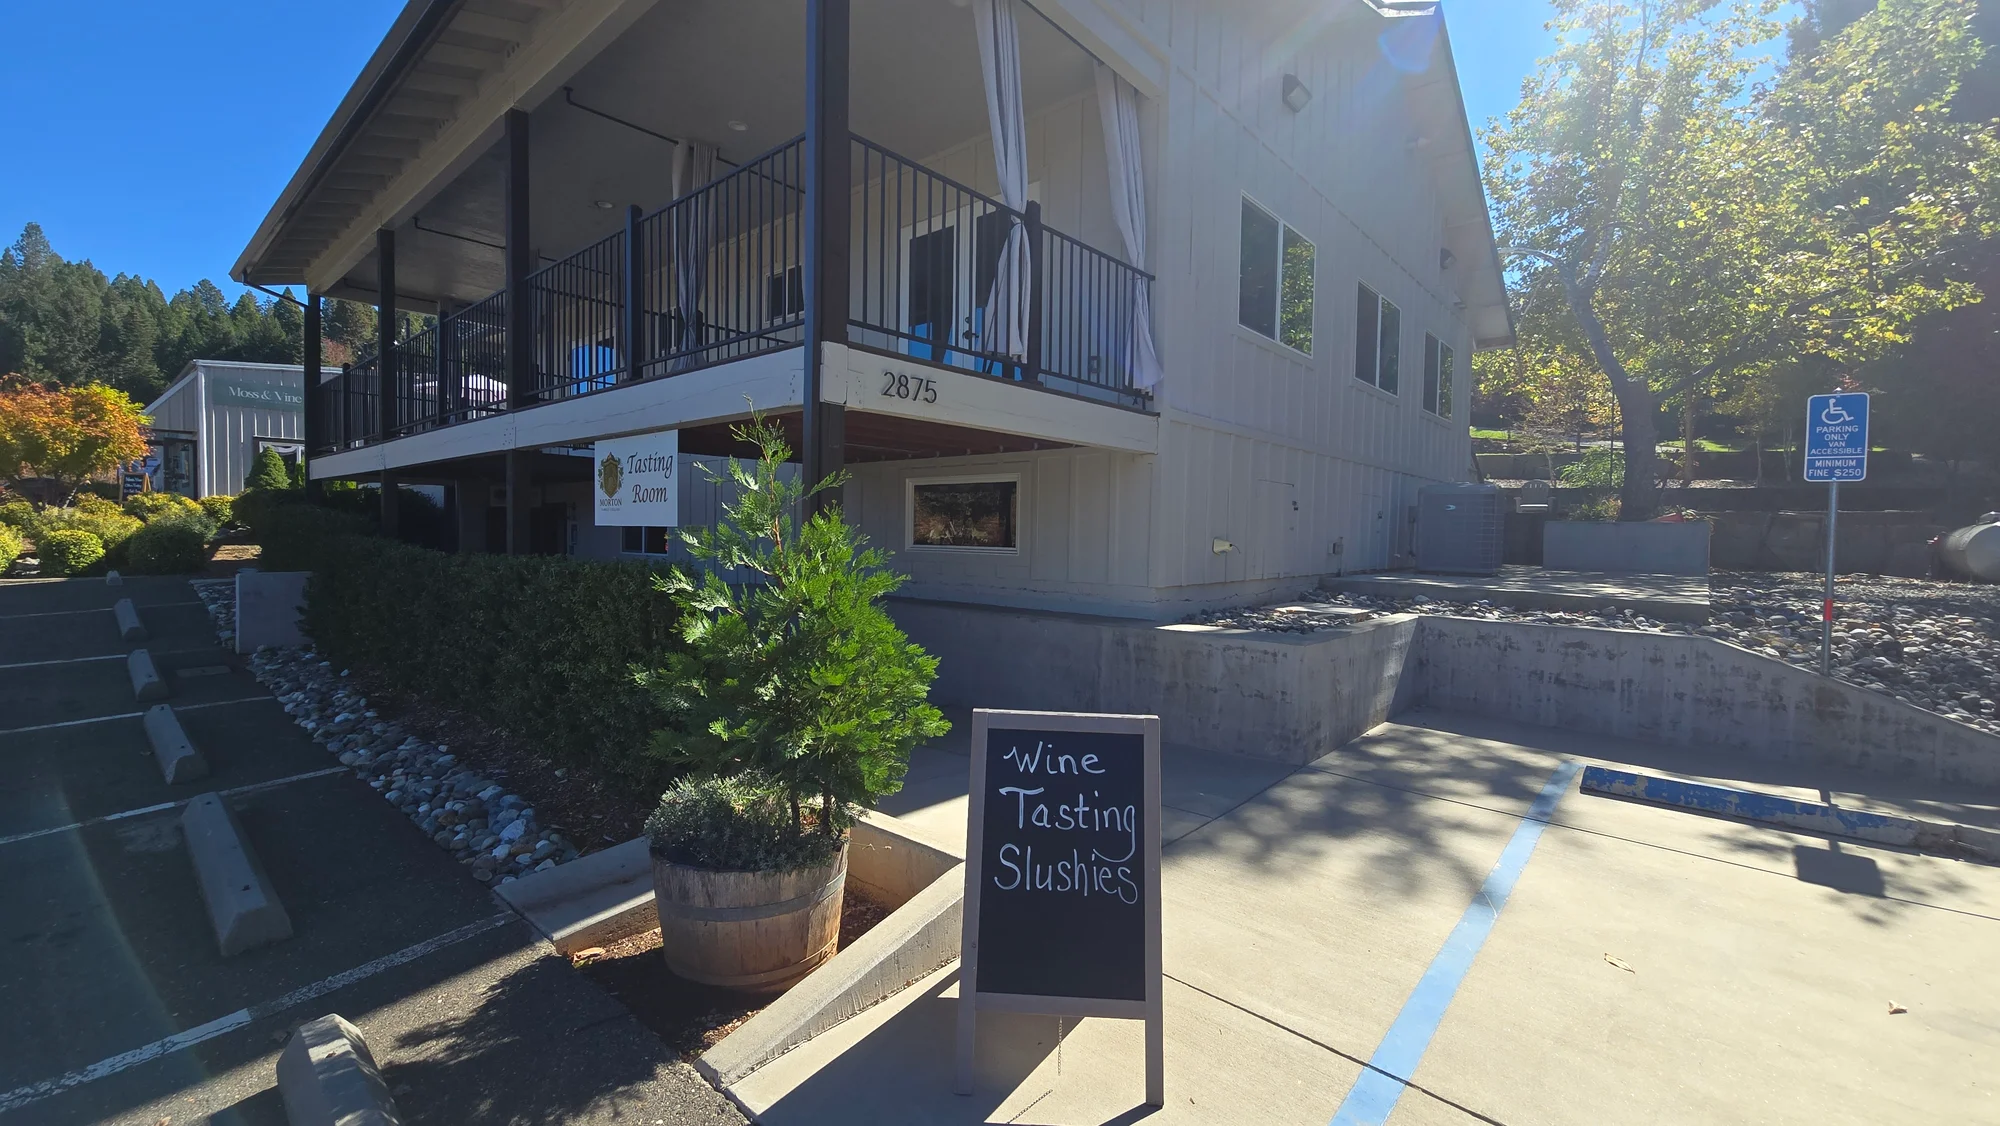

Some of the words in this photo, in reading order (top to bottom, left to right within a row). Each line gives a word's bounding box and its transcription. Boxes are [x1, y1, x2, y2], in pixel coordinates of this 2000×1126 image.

[228, 386, 260, 399] Moss
[261, 390, 272, 400] &
[274, 391, 303, 404] Vine
[881, 371, 937, 404] 2875
[1816, 425, 1859, 433] PARKING
[1824, 433, 1849, 441] ONLY
[1810, 447, 1863, 455] ACCESSIBLE
[626, 451, 674, 479] Tasting
[1815, 459, 1857, 467] MINIMUM
[1808, 469, 1829, 477] FINE
[599, 498, 622, 507] MORTON
[631, 484, 668, 504] Room
[1003, 741, 1106, 775] Wine
[998, 786, 1136, 863] Tasting
[994, 843, 1138, 904] Slushies
